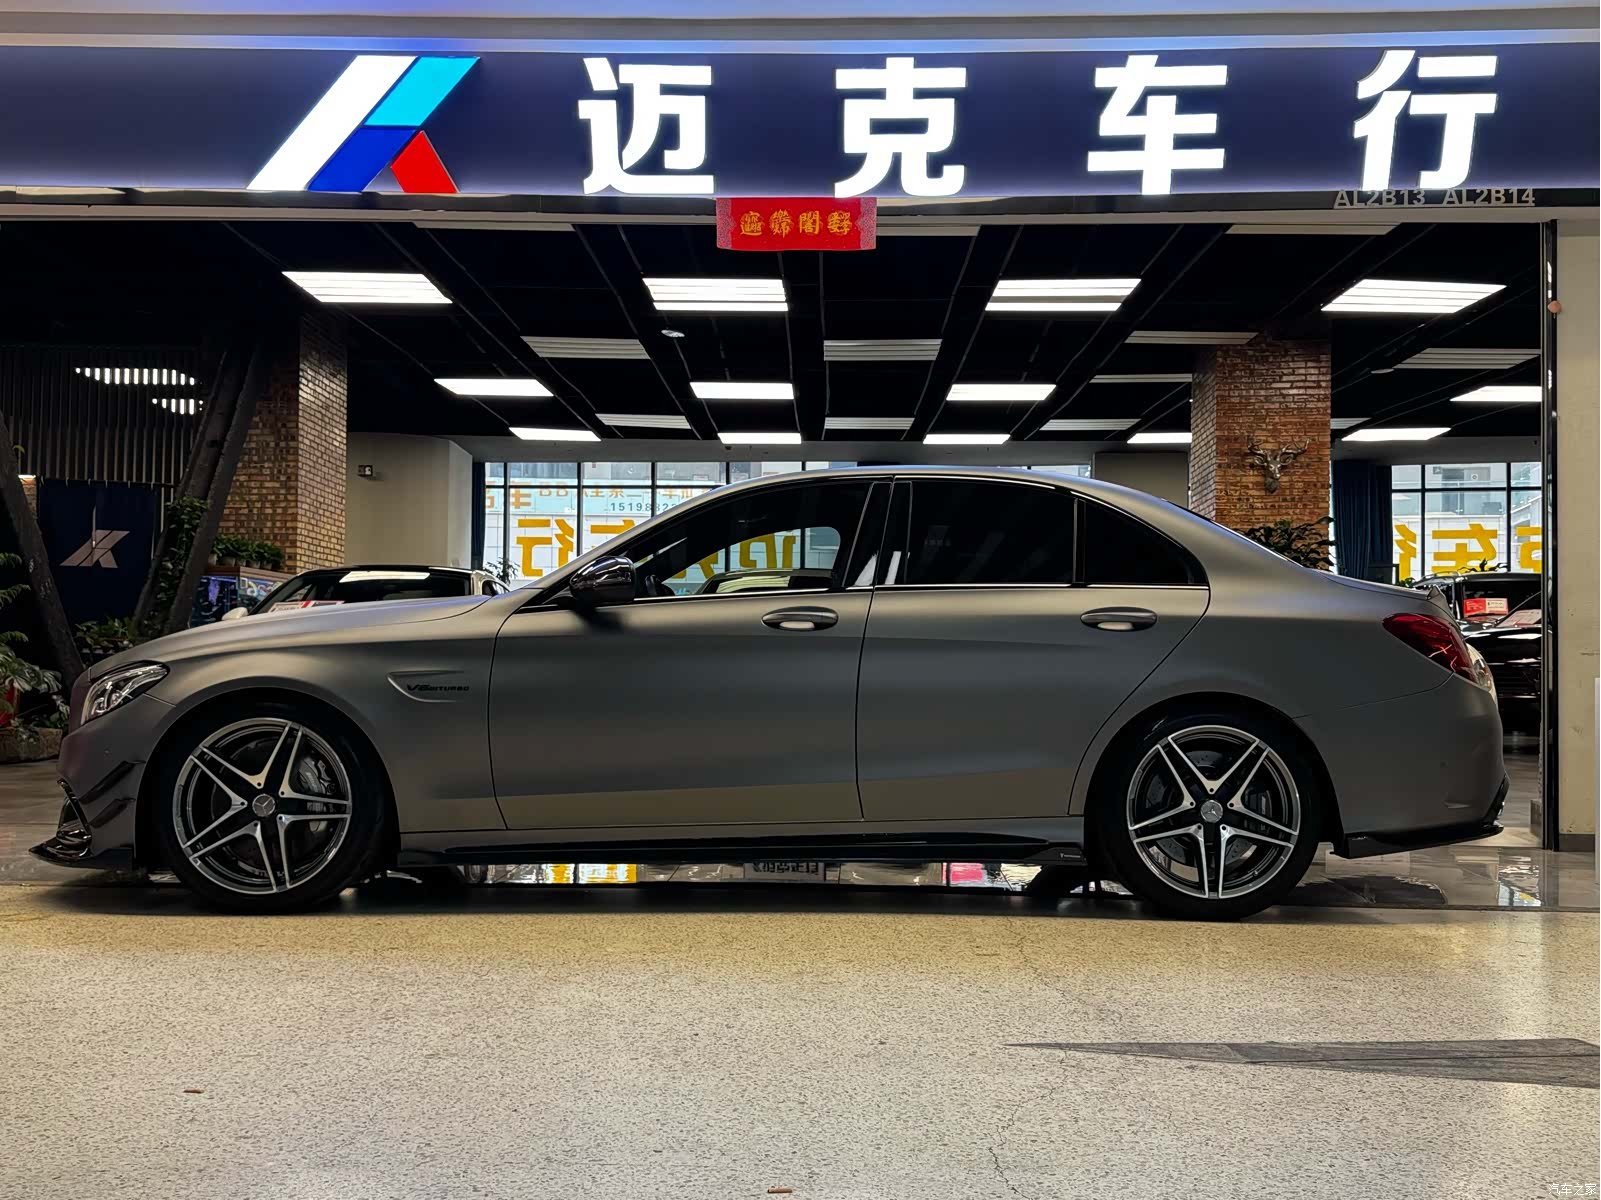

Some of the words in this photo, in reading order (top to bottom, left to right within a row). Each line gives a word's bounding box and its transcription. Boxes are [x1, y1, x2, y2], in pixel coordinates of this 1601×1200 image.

[578, 49, 1498, 197] 迈克车行
[1334, 188, 1426, 208] AL2B13
[1442, 188, 1536, 208] AL2B14
